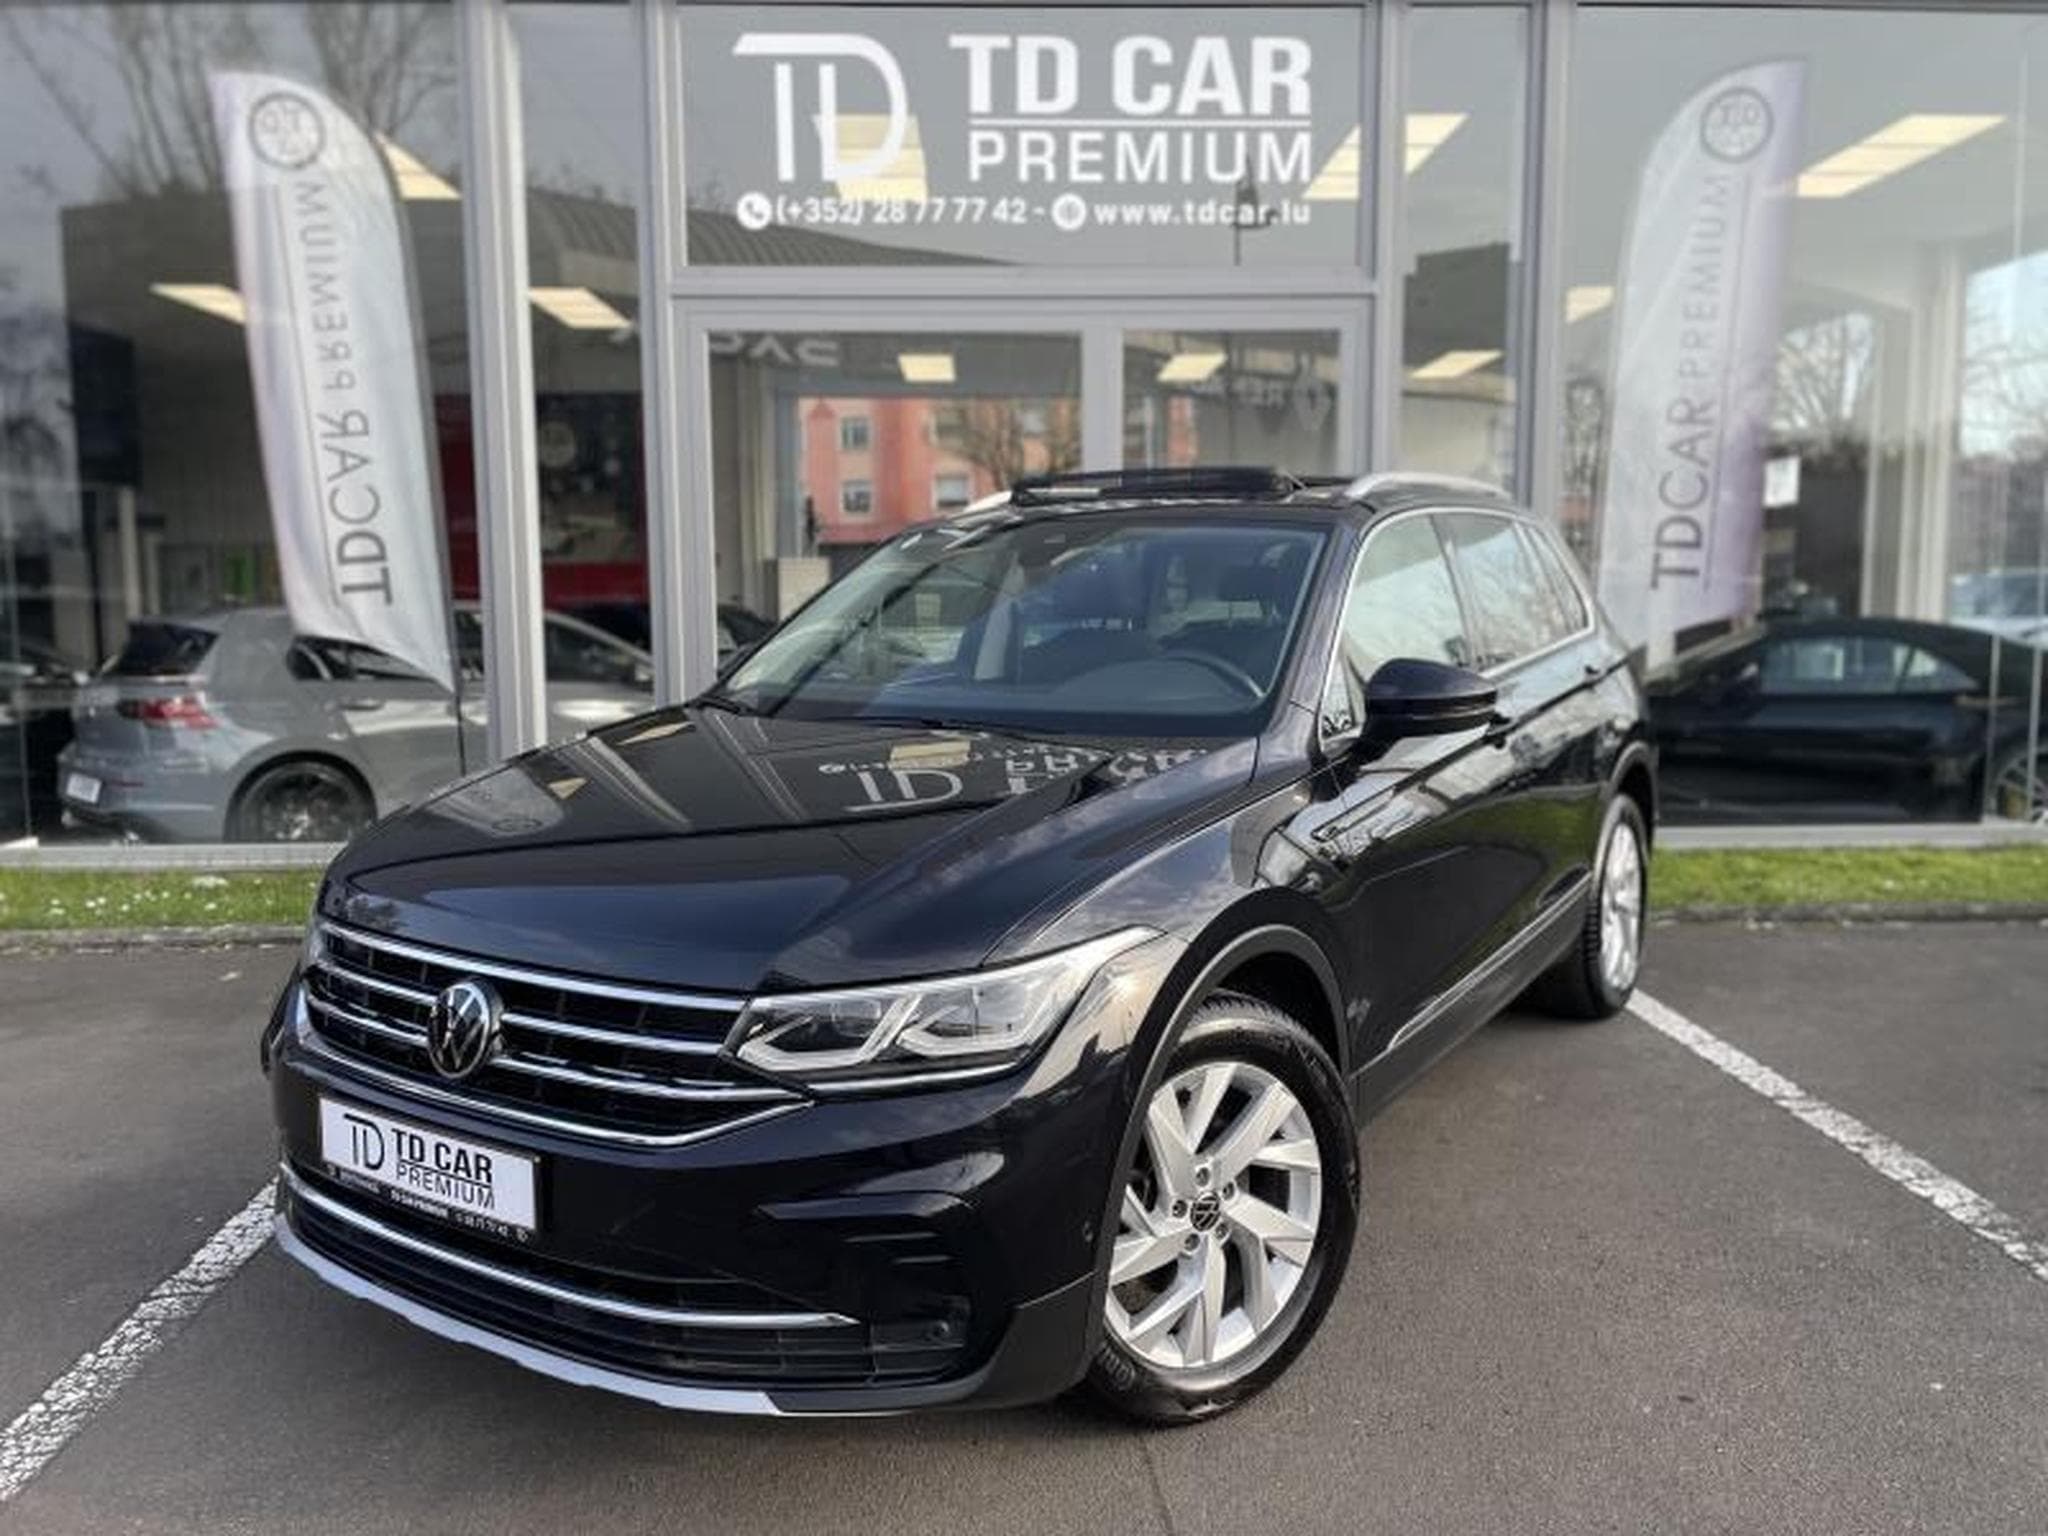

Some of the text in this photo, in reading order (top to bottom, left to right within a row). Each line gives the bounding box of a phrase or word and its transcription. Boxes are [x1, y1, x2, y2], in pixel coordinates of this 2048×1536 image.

[948, 34, 1313, 116] TD CAR
[968, 131, 1313, 183] PREMIUM
[776, 196, 864, 226] (+352)
[872, 197, 906, 224] 28
[912, 197, 946, 224] 77
[952, 197, 988, 224] 77
[992, 197, 1028, 225] 42
[1093, 199, 1312, 226] www.tdcar.lu
[1679, 174, 1729, 379] PREMIUM
[391, 1127, 493, 1183] TD CAR
[396, 1164, 496, 1210] PREMIUM
